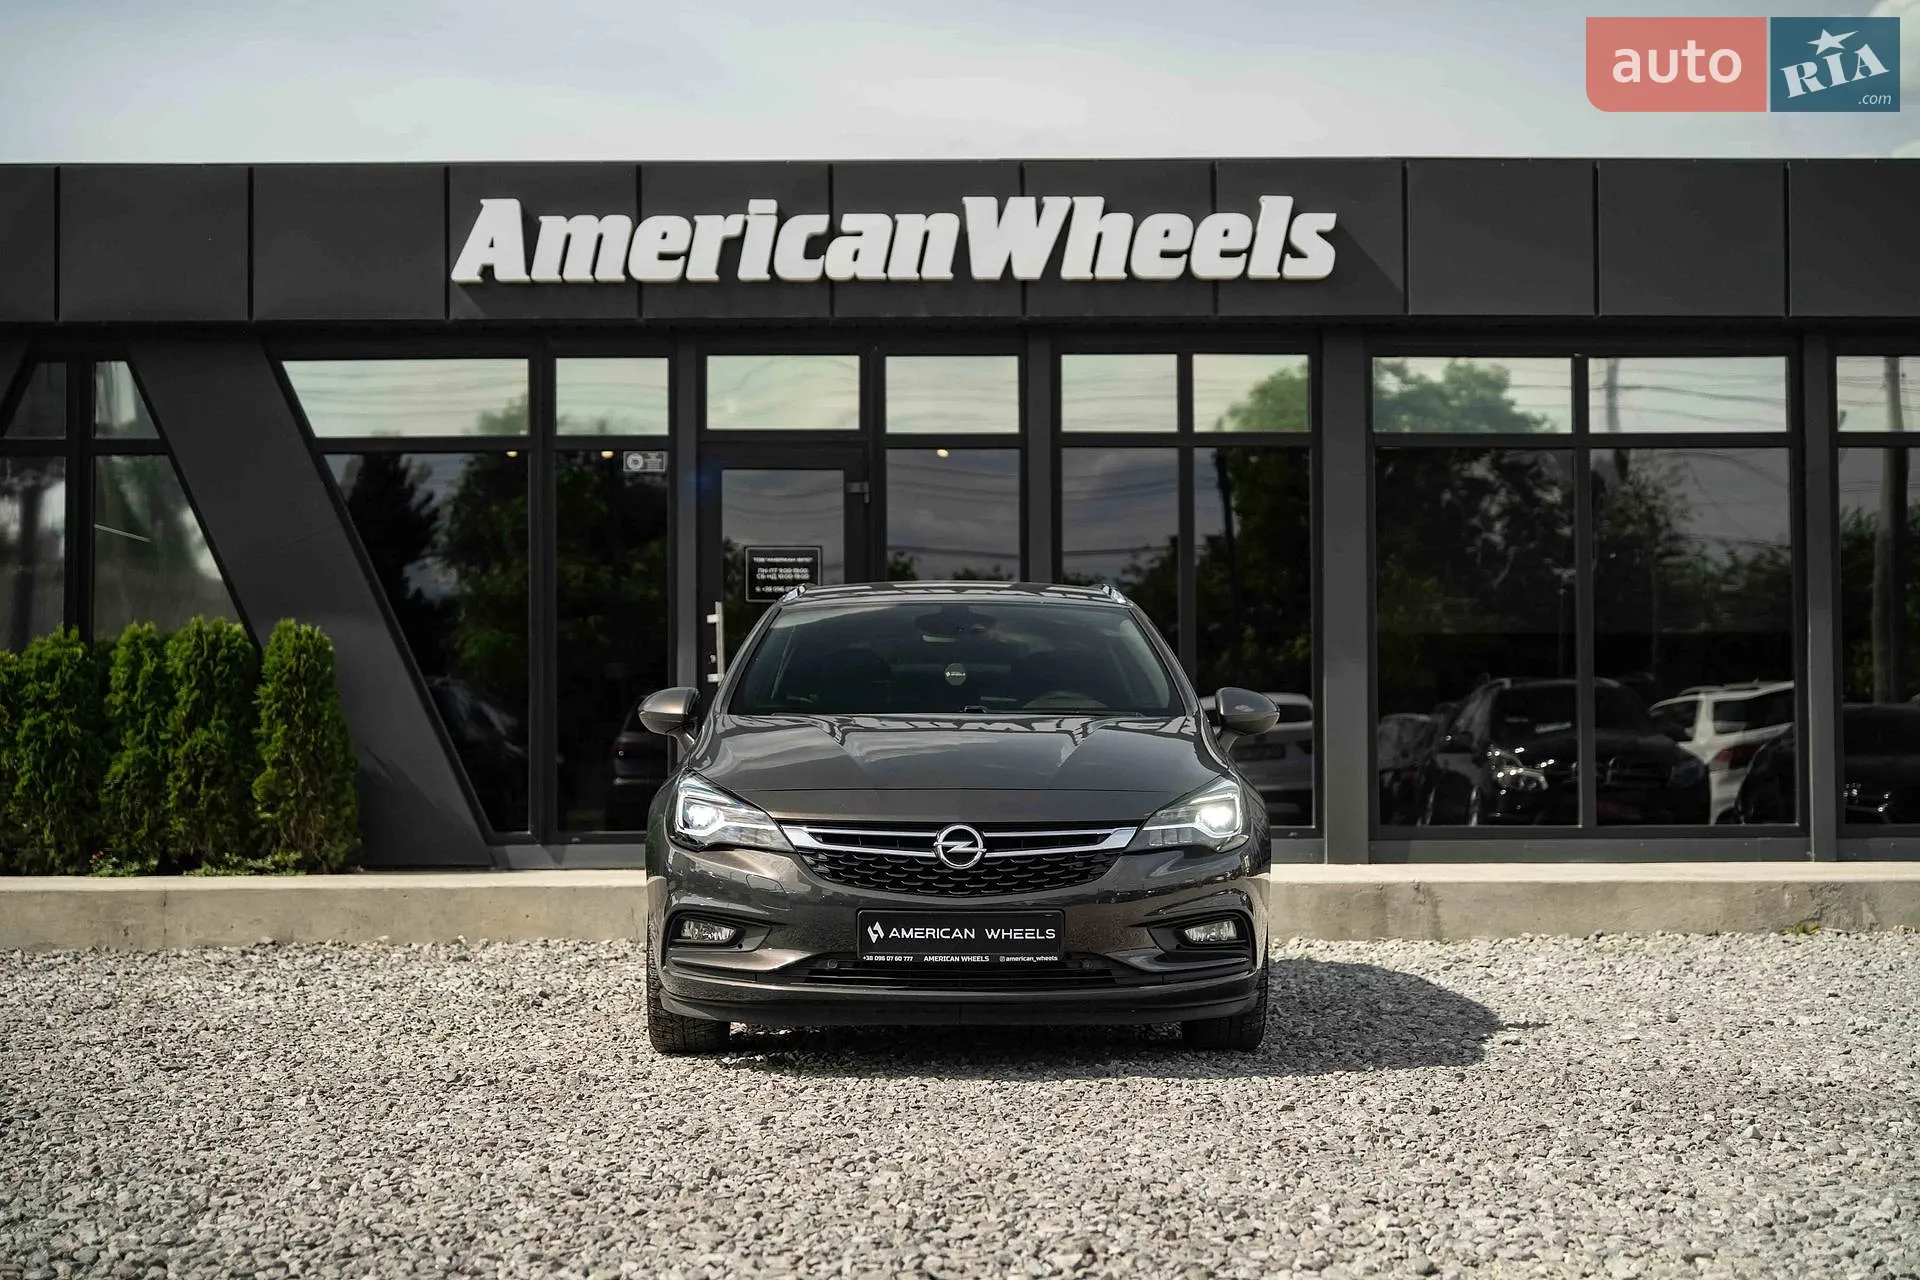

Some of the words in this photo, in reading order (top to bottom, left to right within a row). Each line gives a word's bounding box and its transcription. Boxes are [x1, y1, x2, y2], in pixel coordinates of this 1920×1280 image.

[452, 195, 1337, 284] AmericanWheels
[888, 927, 975, 940] AMERICAN
[984, 928, 1056, 940] WHEELS
